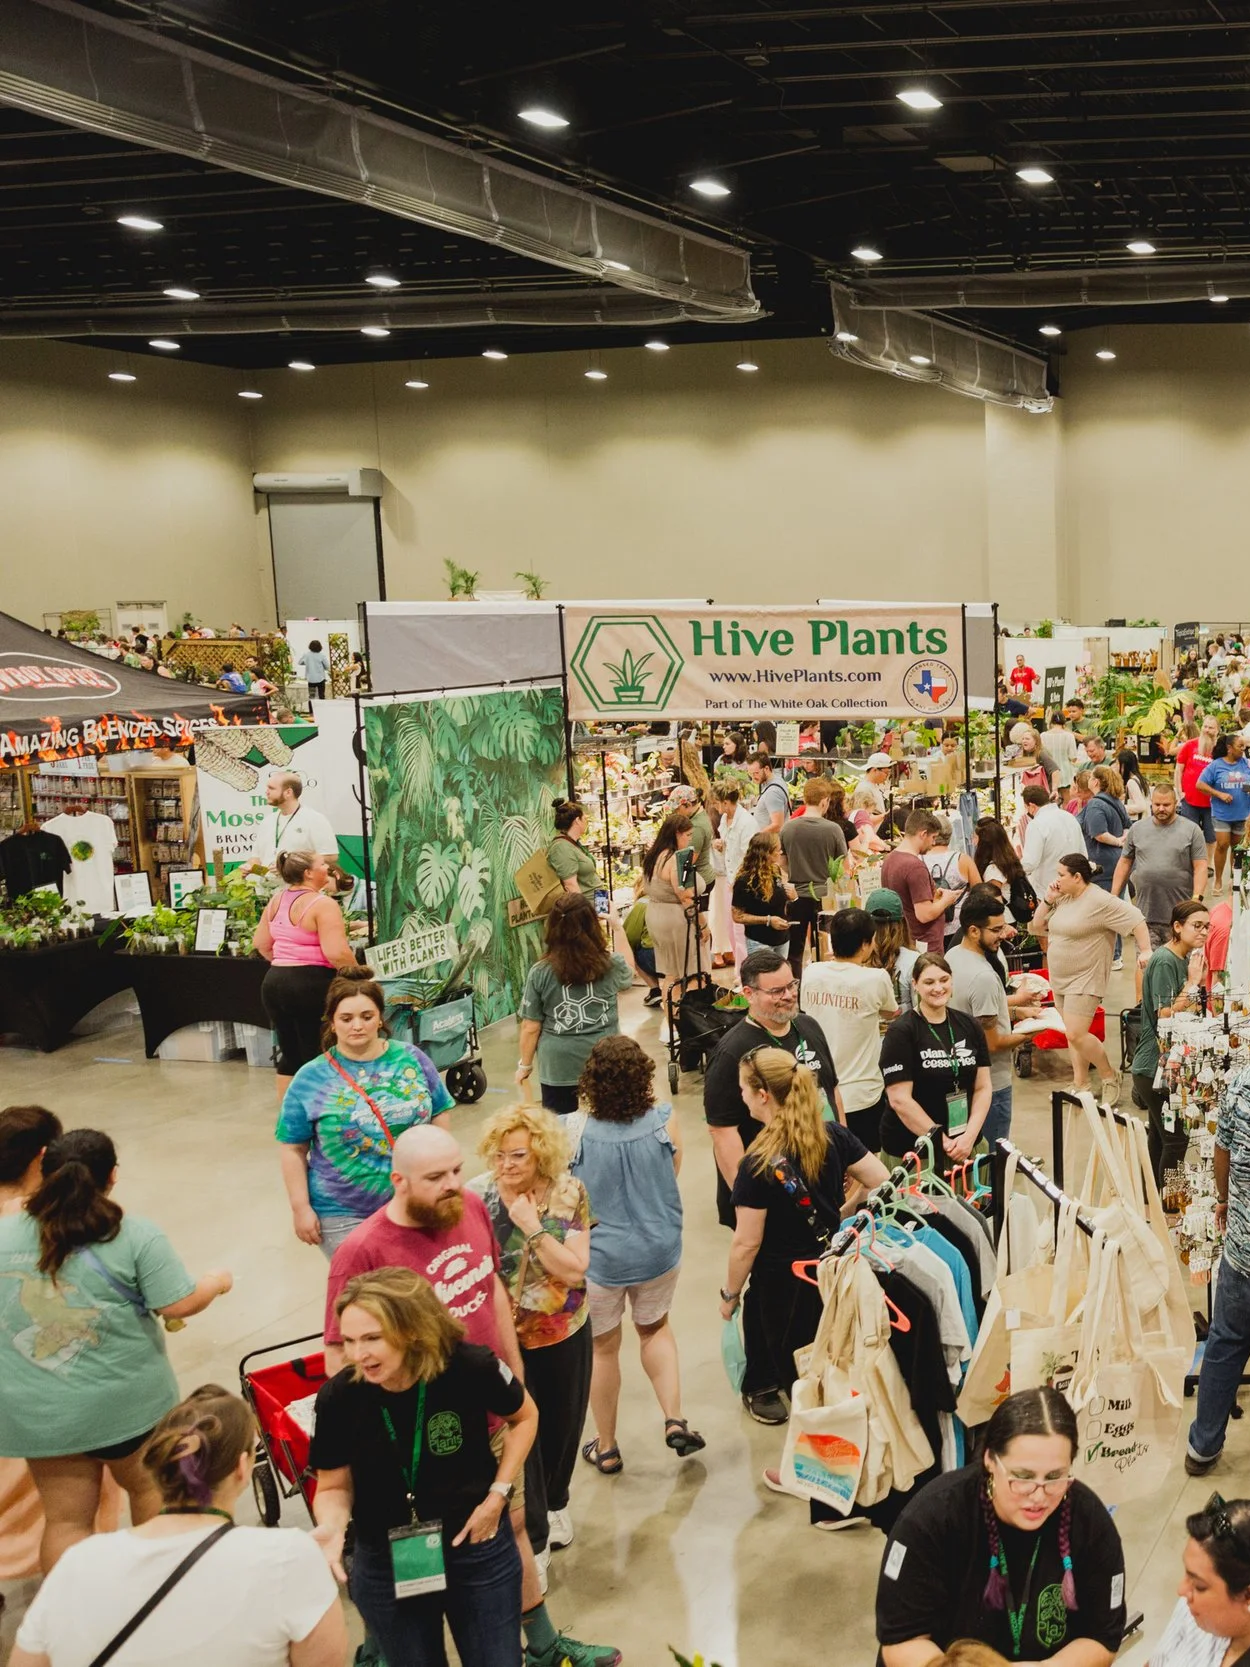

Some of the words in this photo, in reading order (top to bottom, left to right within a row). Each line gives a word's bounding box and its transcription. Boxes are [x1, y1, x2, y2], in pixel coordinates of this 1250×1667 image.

[689, 620, 793, 657] Hive
[808, 620, 948, 656] Plants
[709, 669, 881, 684] www.HivePlants.com
[705, 698, 727, 709] Part
[731, 698, 744, 709] of
[746, 698, 766, 709] The
[769, 698, 803, 709] White
[806, 698, 828, 709] Oak
[831, 698, 888, 709] Collection
[1, 731, 79, 757] AMAZING
[82, 719, 162, 745] BLENDED
[250, 795, 267, 807] Th
[206, 810, 265, 828] Moss
[222, 845, 253, 855] HOM
[512, 909, 536, 924] PLANT
[377, 941, 406, 962] LIFE'S
[410, 929, 446, 951] BETTER
[381, 957, 406, 975] WITH
[410, 944, 446, 968] PLANTS
[807, 992, 859, 1010] VOLUNTEER
[426, 1243, 473, 1275] ORIGINAL
[1104, 1422, 1135, 1438] Eggs
